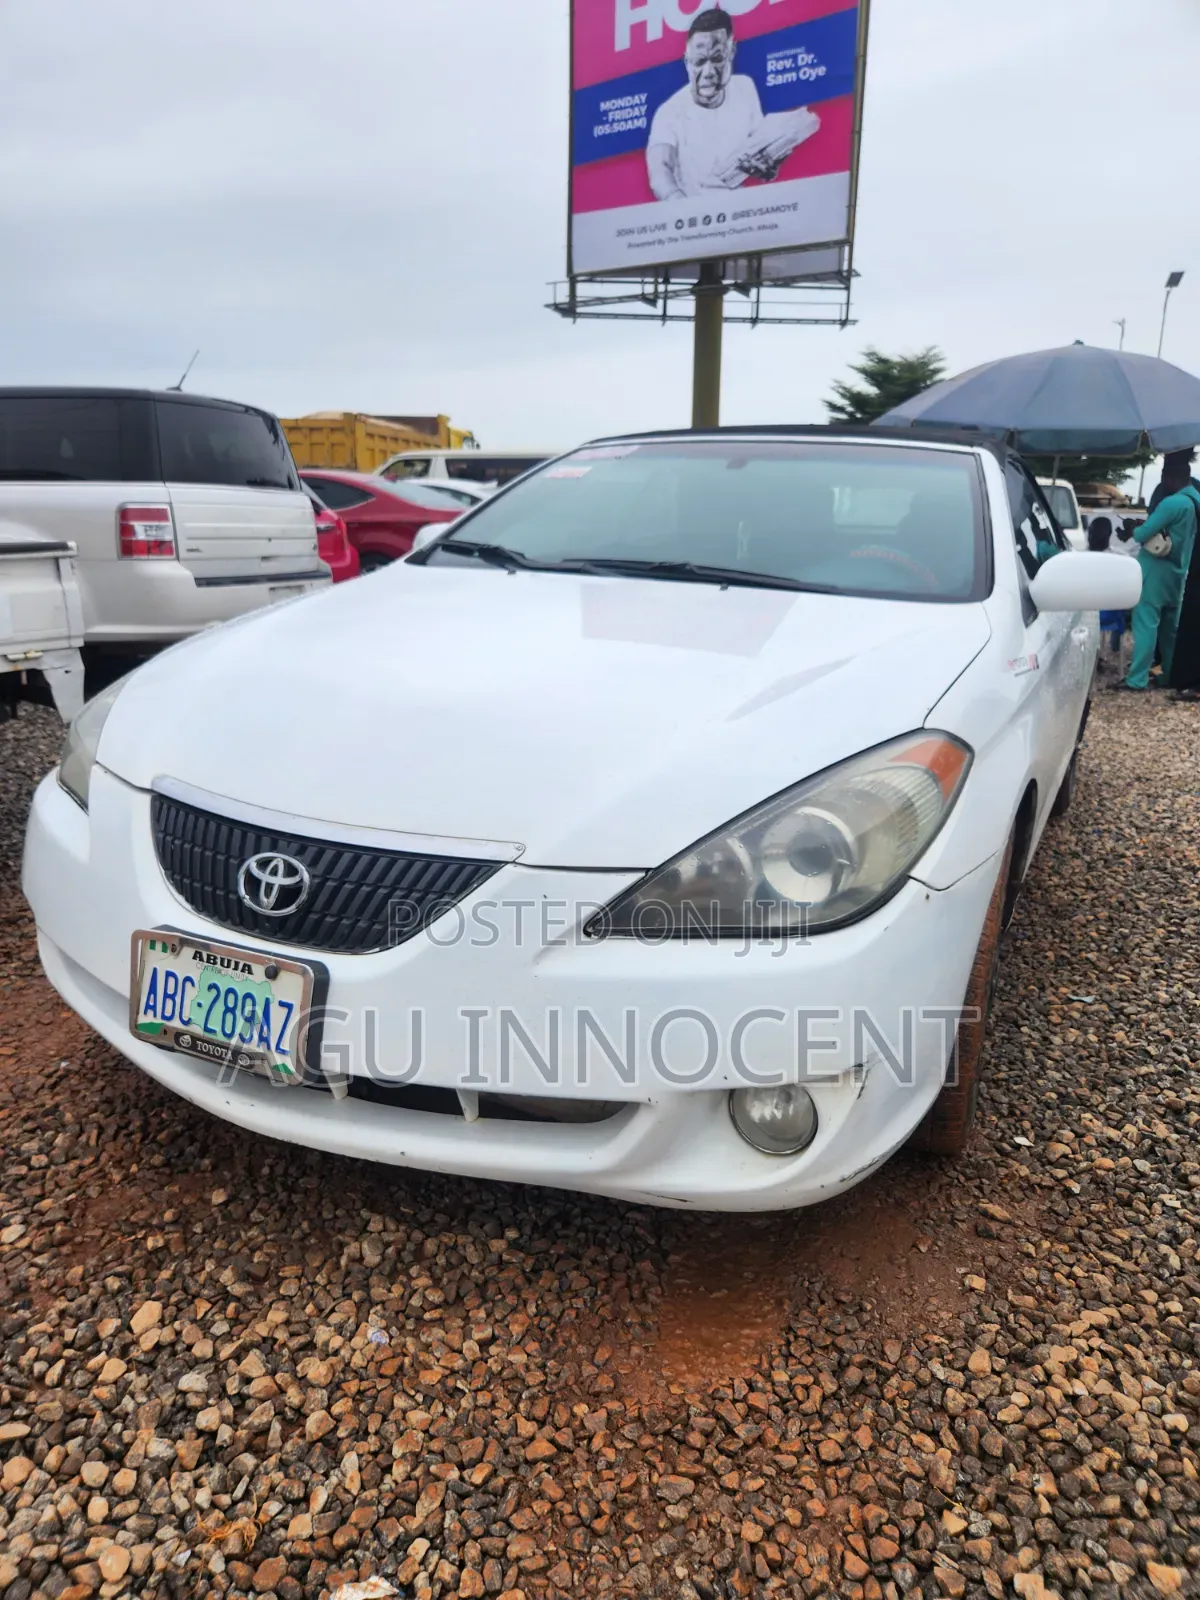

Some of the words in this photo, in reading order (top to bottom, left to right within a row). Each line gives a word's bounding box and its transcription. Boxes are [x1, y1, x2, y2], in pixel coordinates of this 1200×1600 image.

[767, 58, 795, 73] Rev.
[797, 53, 818, 67] Dr.
[766, 72, 797, 87] Sam
[798, 65, 826, 81] Oye
[599, 93, 648, 112] MONDAY
[608, 104, 648, 122] FRIDAY
[616, 227, 635, 238] JOIN
[649, 222, 667, 234] LIVE
[192, 949, 254, 976] ABUJA
[196, 1040, 234, 1061] TOYOTA
